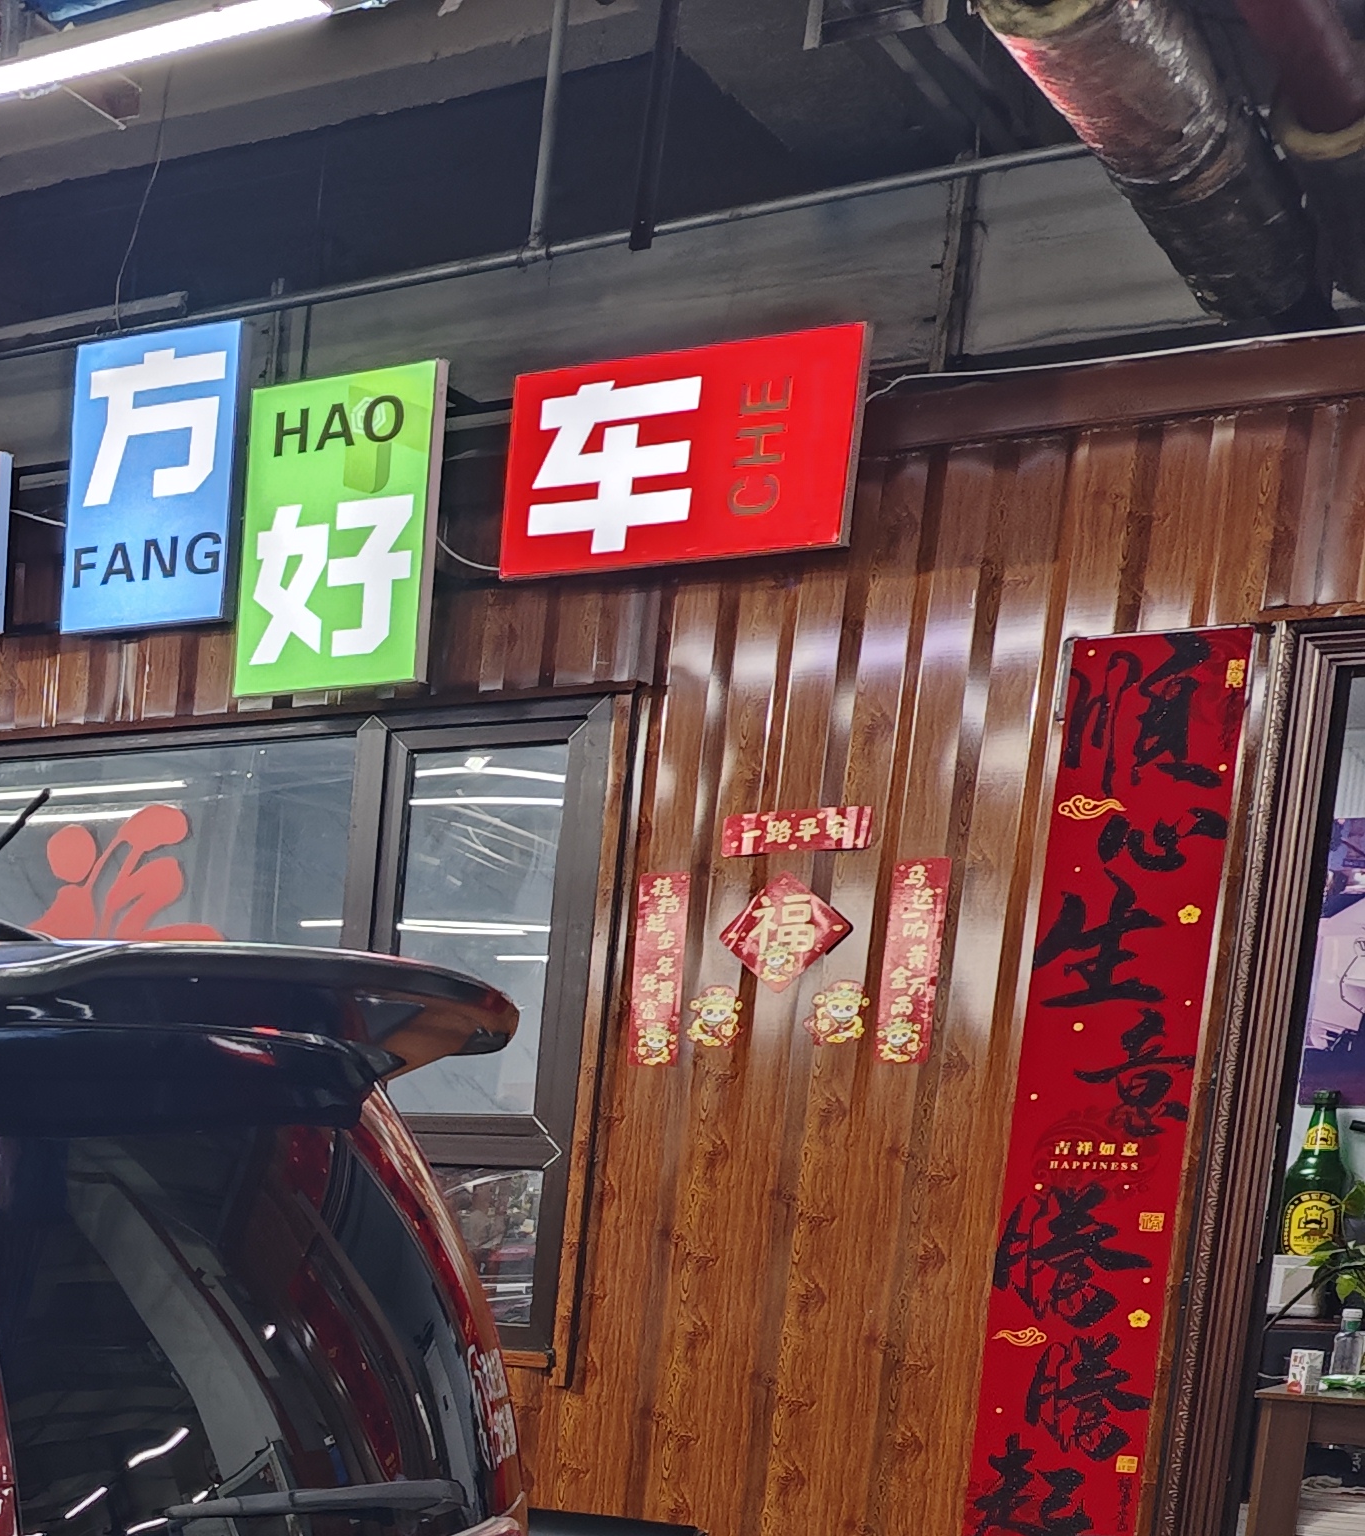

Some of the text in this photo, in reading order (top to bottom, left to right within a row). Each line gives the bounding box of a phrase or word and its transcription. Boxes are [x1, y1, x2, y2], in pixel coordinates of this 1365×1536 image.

[82, 347, 227, 508] 方
[272, 394, 406, 458] HAO
[728, 374, 793, 517] CHE
[527, 375, 703, 555] 车
[72, 531, 222, 590] FANG
[249, 493, 414, 666] 好
[741, 814, 848, 843] 一路平安
[749, 894, 816, 954] 福
[1049, 1160, 1139, 1171] HAPPINESS
